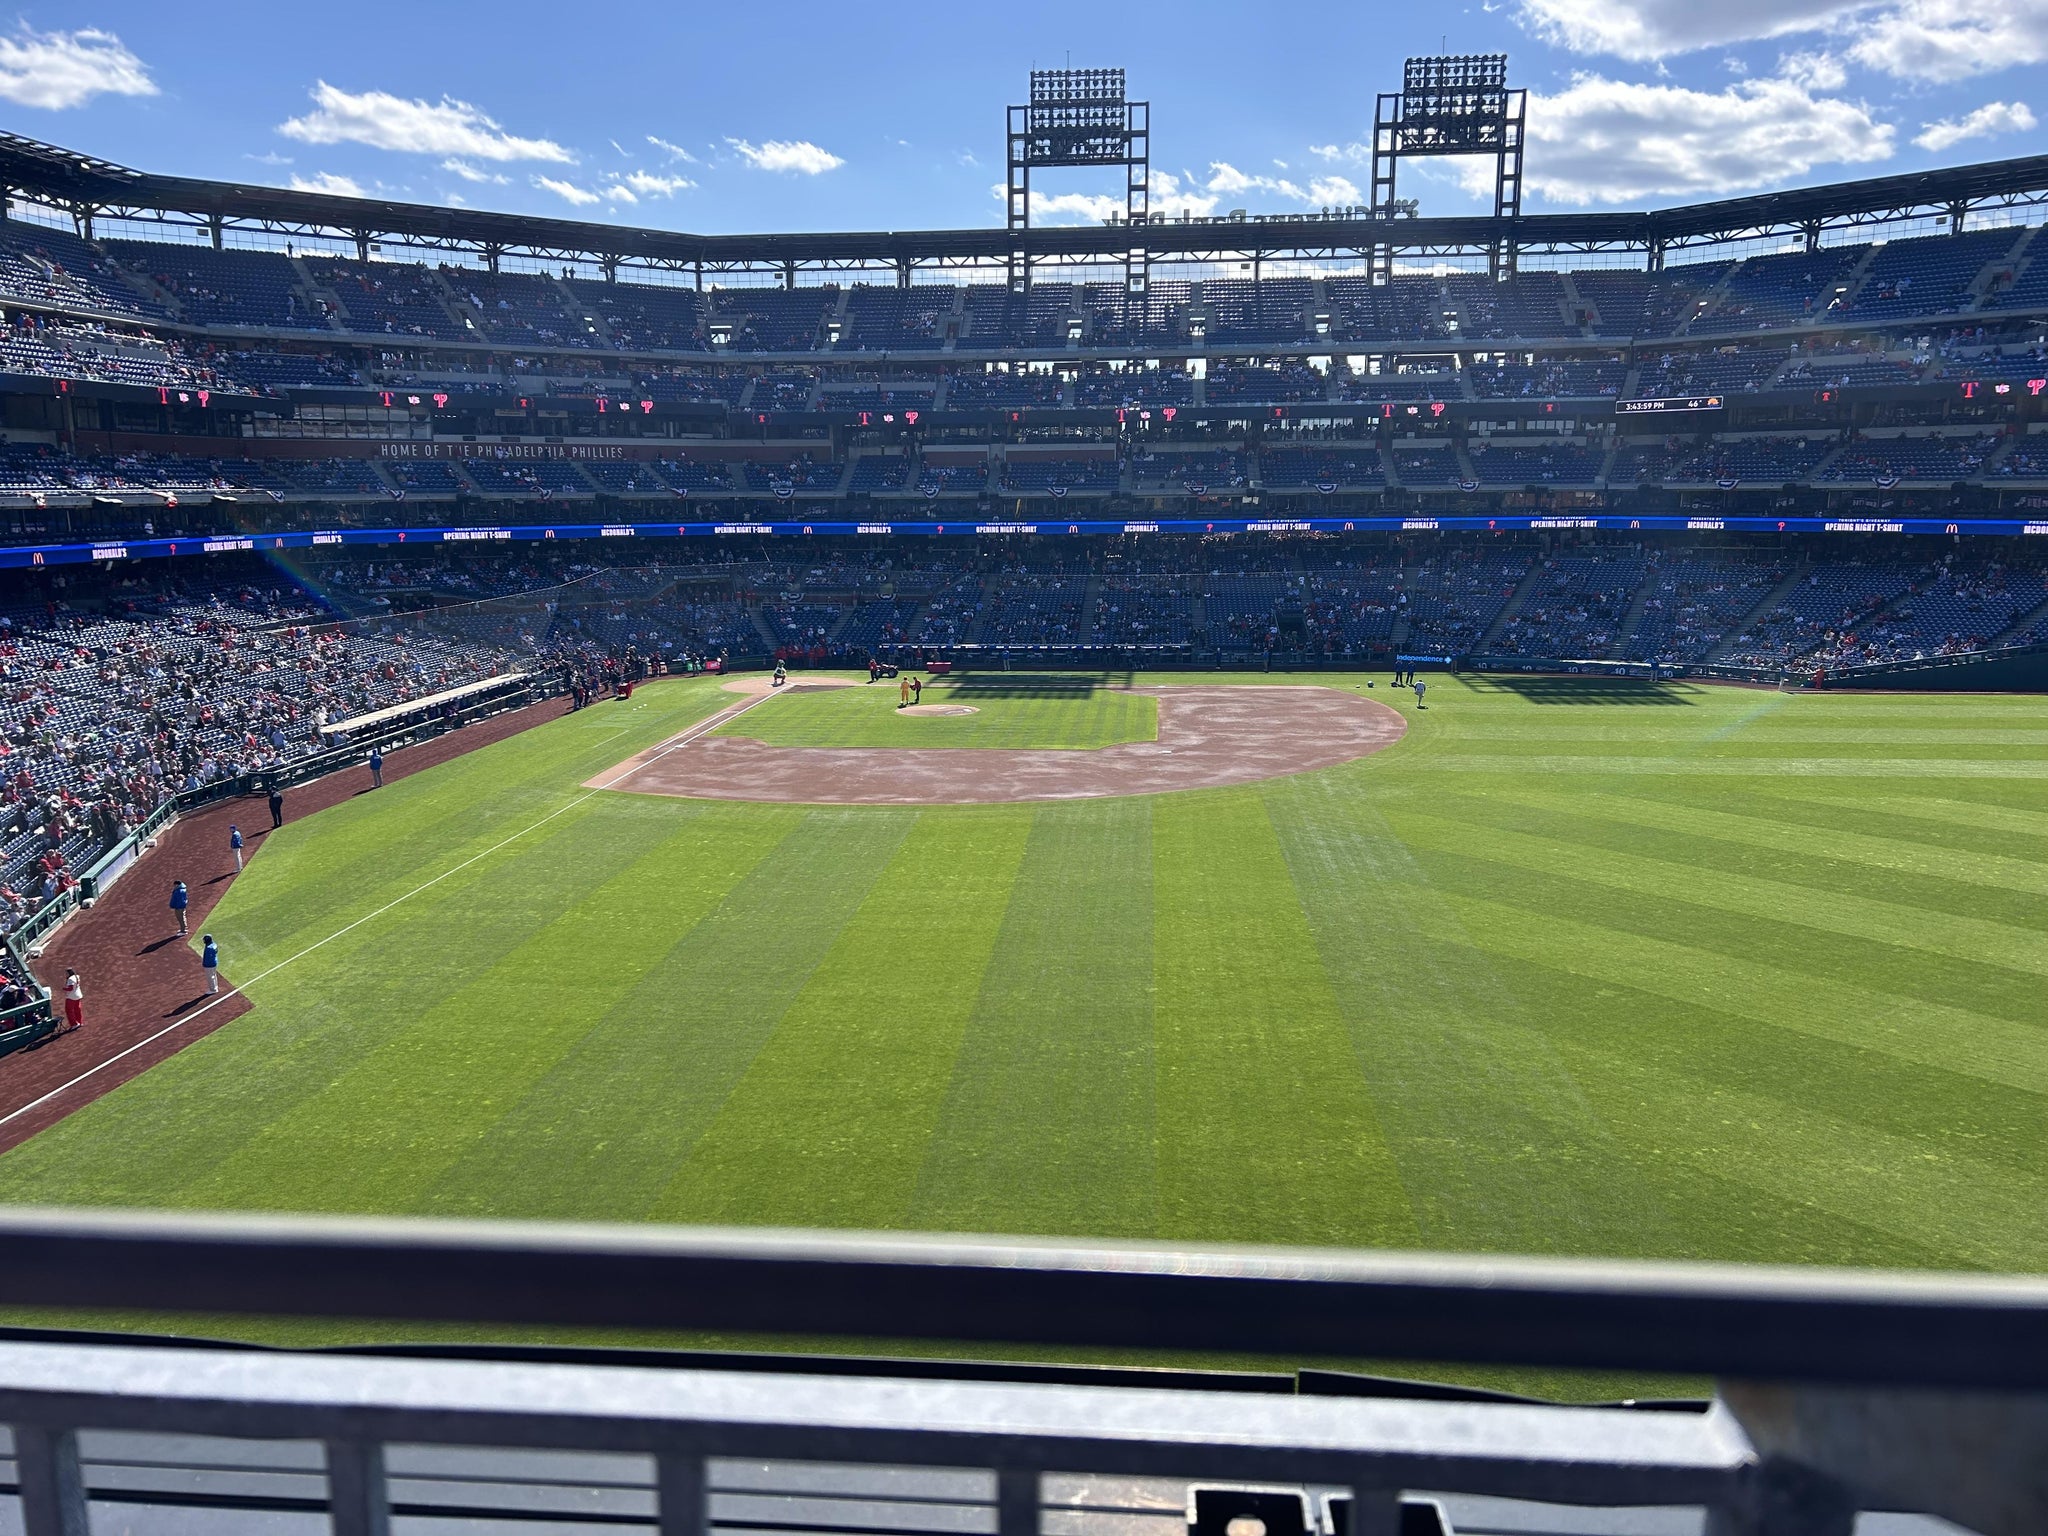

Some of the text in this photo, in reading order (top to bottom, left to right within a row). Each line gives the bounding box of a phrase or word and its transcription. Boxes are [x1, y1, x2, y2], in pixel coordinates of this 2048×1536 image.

[1626, 402, 1652, 411] 3:43:59
[381, 444, 418, 457] HOME
[425, 444, 440, 457] OF
[572, 446, 623, 458] PHILLIES
[1687, 521, 1725, 529] MCDONALD'S
[1825, 522, 1904, 532] OPENING NIGHT T-SHIRT
[1396, 654, 1444, 663] Independence
[1615, 667, 1625, 675] 10
